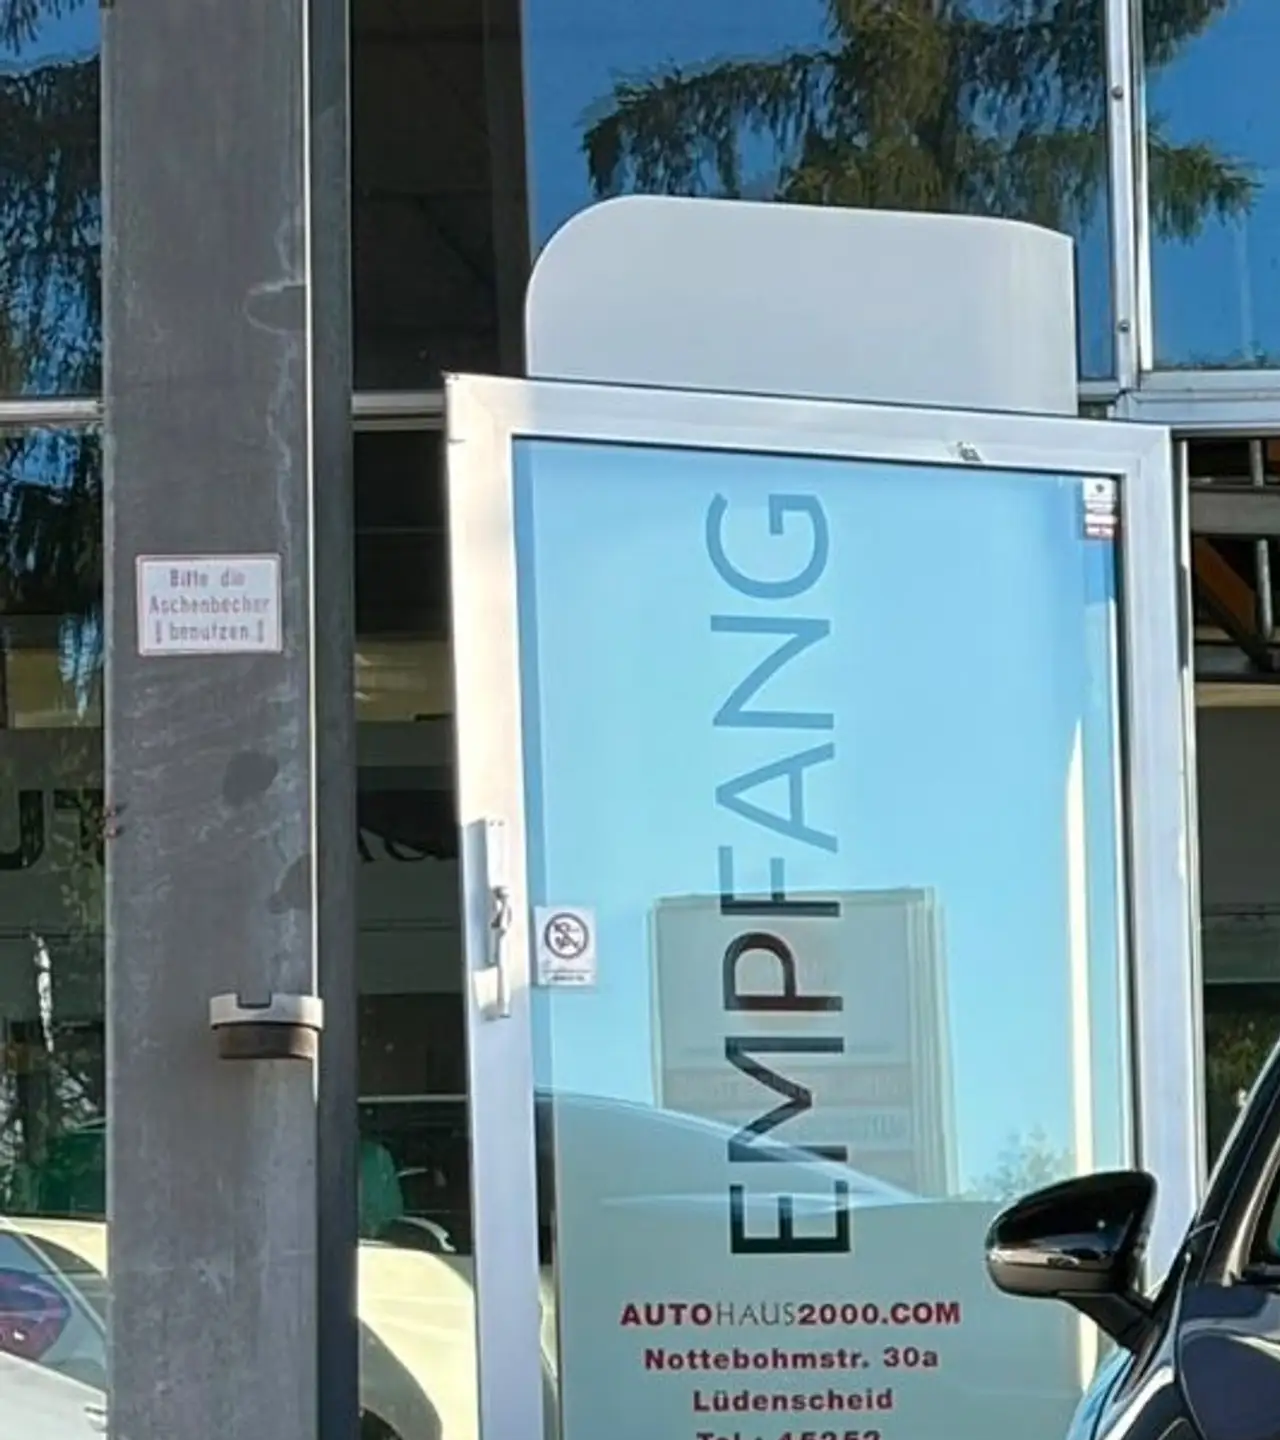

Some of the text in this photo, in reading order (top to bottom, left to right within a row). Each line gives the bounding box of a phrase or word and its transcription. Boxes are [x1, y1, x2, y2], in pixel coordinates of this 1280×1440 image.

[170, 568, 209, 588] Bitte
[150, 594, 270, 614] Aschenbecher
[706, 493, 850, 1253] EMPFANG
[620, 1301, 961, 1326] AUTOHAUS2000.COM
[643, 1346, 938, 1370] Nottebohmstr. 30a
[692, 1388, 893, 1412] Lüdenscheid
